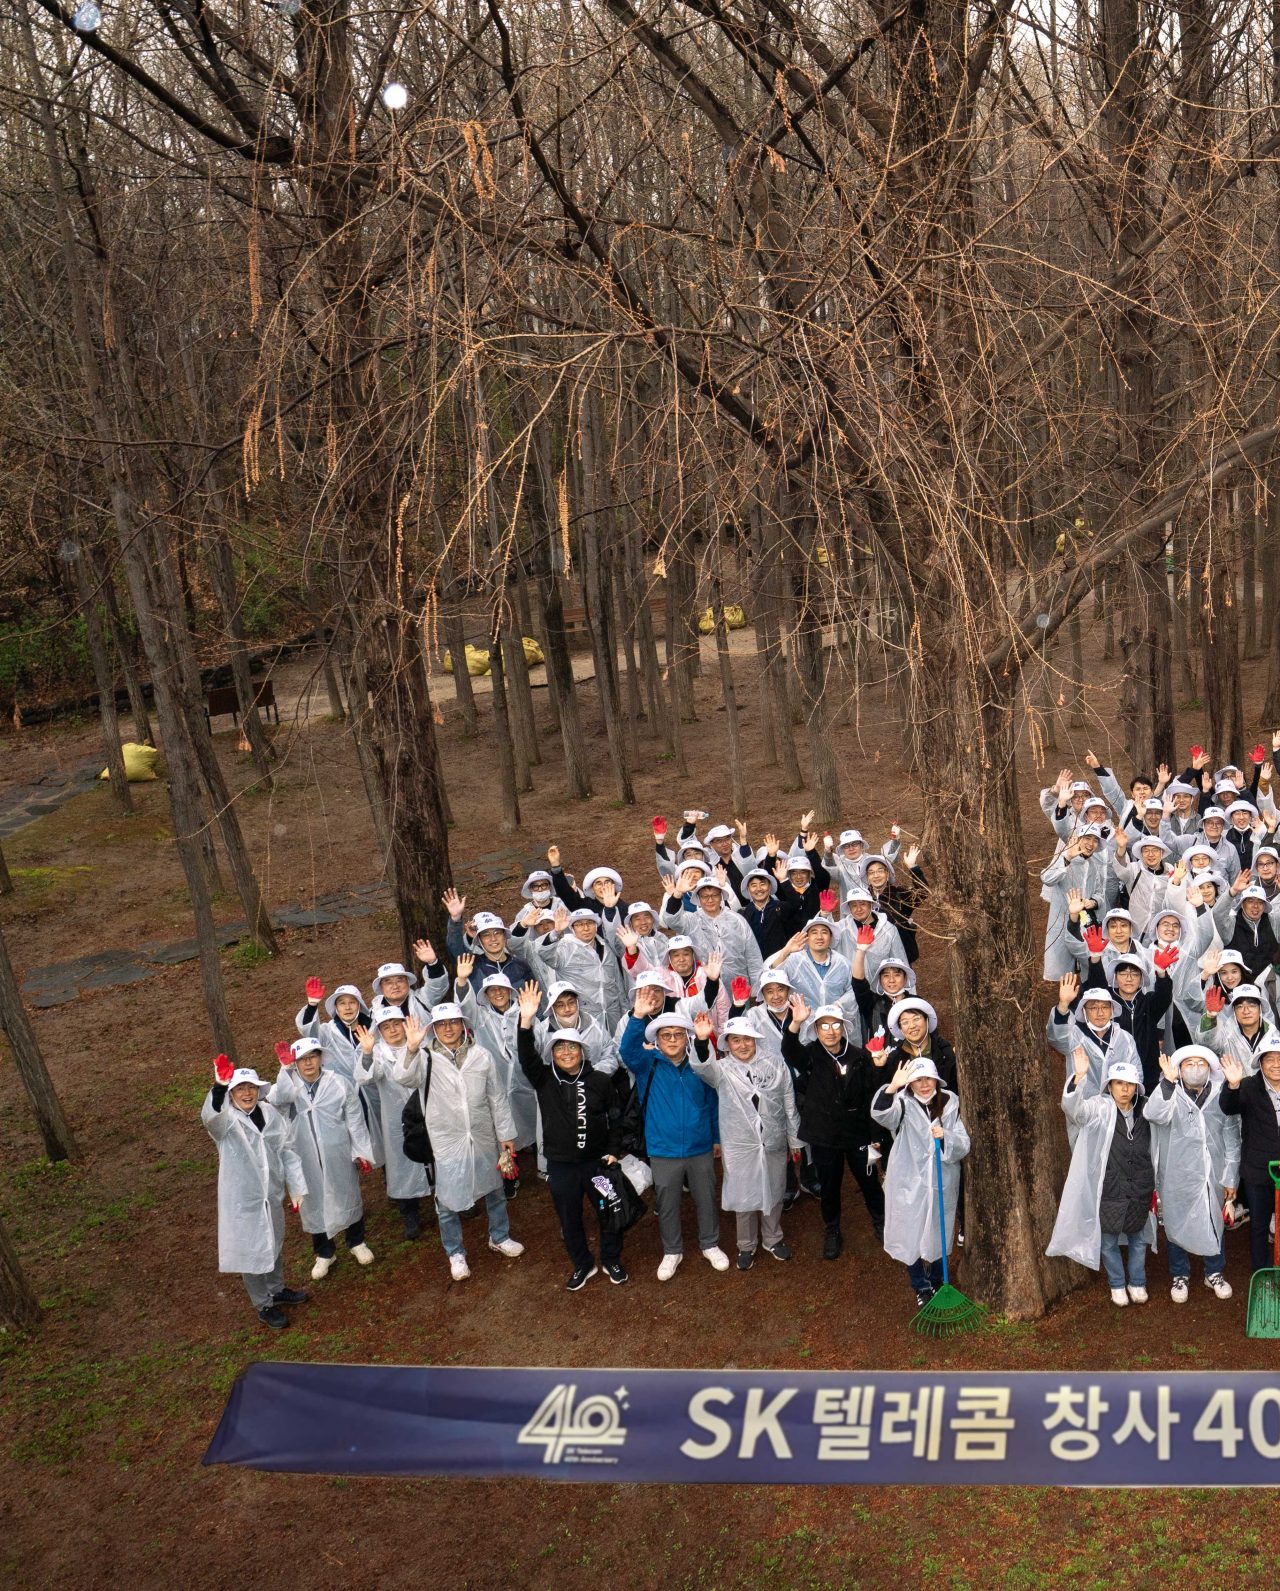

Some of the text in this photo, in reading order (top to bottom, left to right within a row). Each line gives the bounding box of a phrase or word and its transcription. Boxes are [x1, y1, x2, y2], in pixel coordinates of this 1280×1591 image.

[516, 1384, 628, 1464] 40
[679, 1386, 799, 1460] SK
[813, 1385, 1015, 1461] 텔레콤
